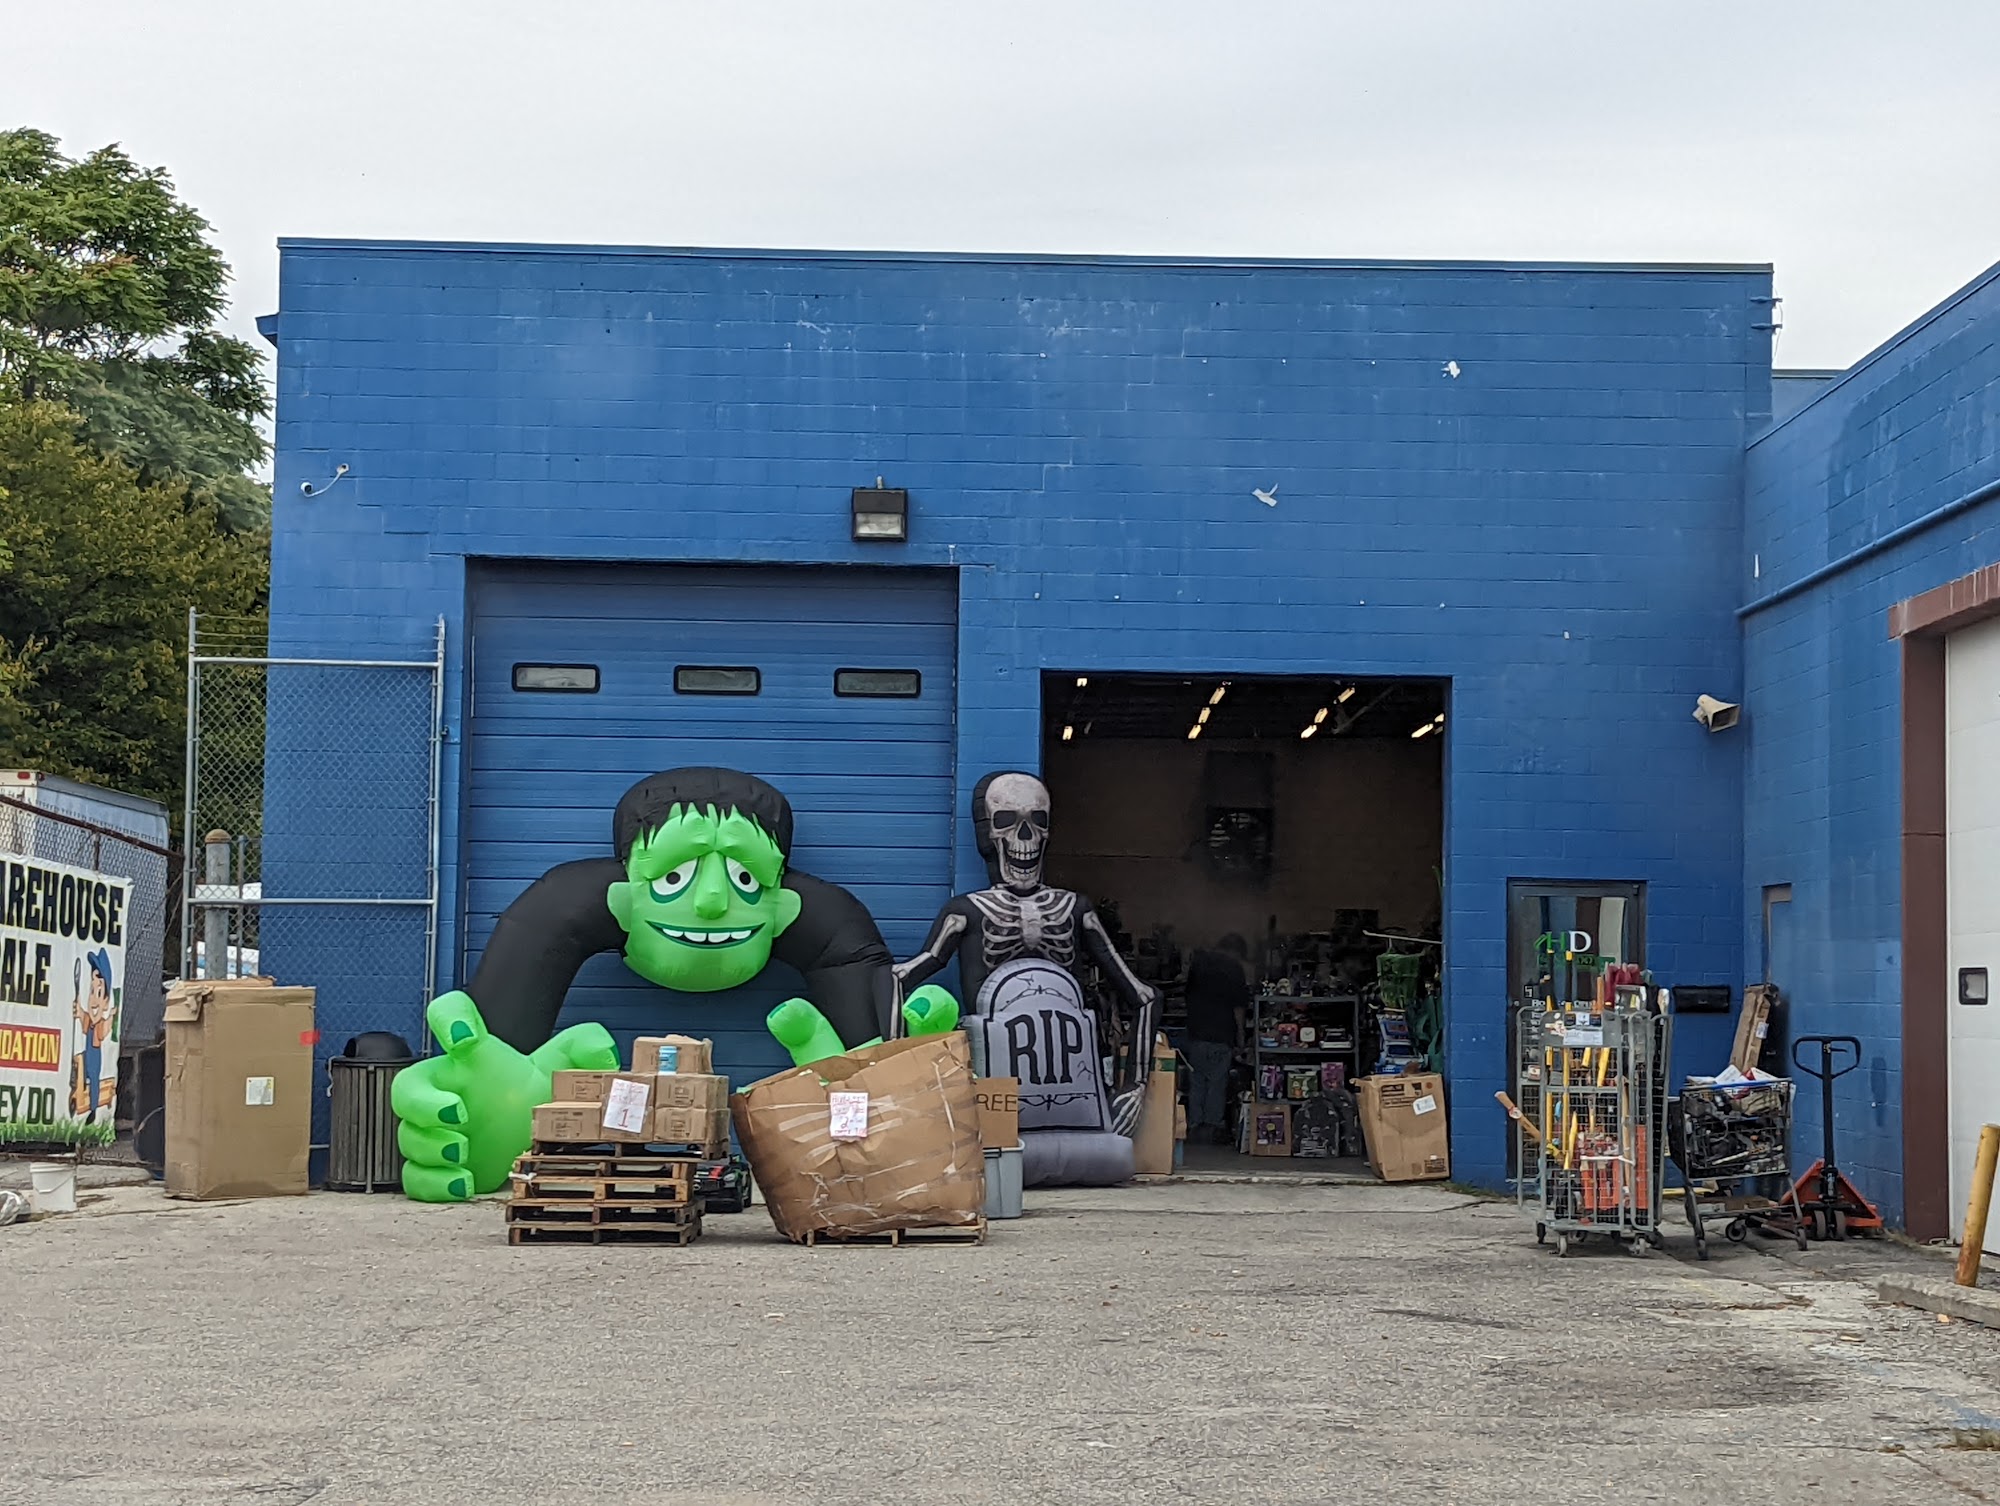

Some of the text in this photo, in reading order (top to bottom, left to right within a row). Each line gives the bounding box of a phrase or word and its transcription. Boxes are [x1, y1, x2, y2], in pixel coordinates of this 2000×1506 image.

[0, 937, 52, 1007] ALE
[0, 1029, 60, 1065] DATION
[1004, 1009, 1083, 1085] RIP
[27, 1086, 55, 1125] DO
[976, 1093, 1017, 1112] REE
